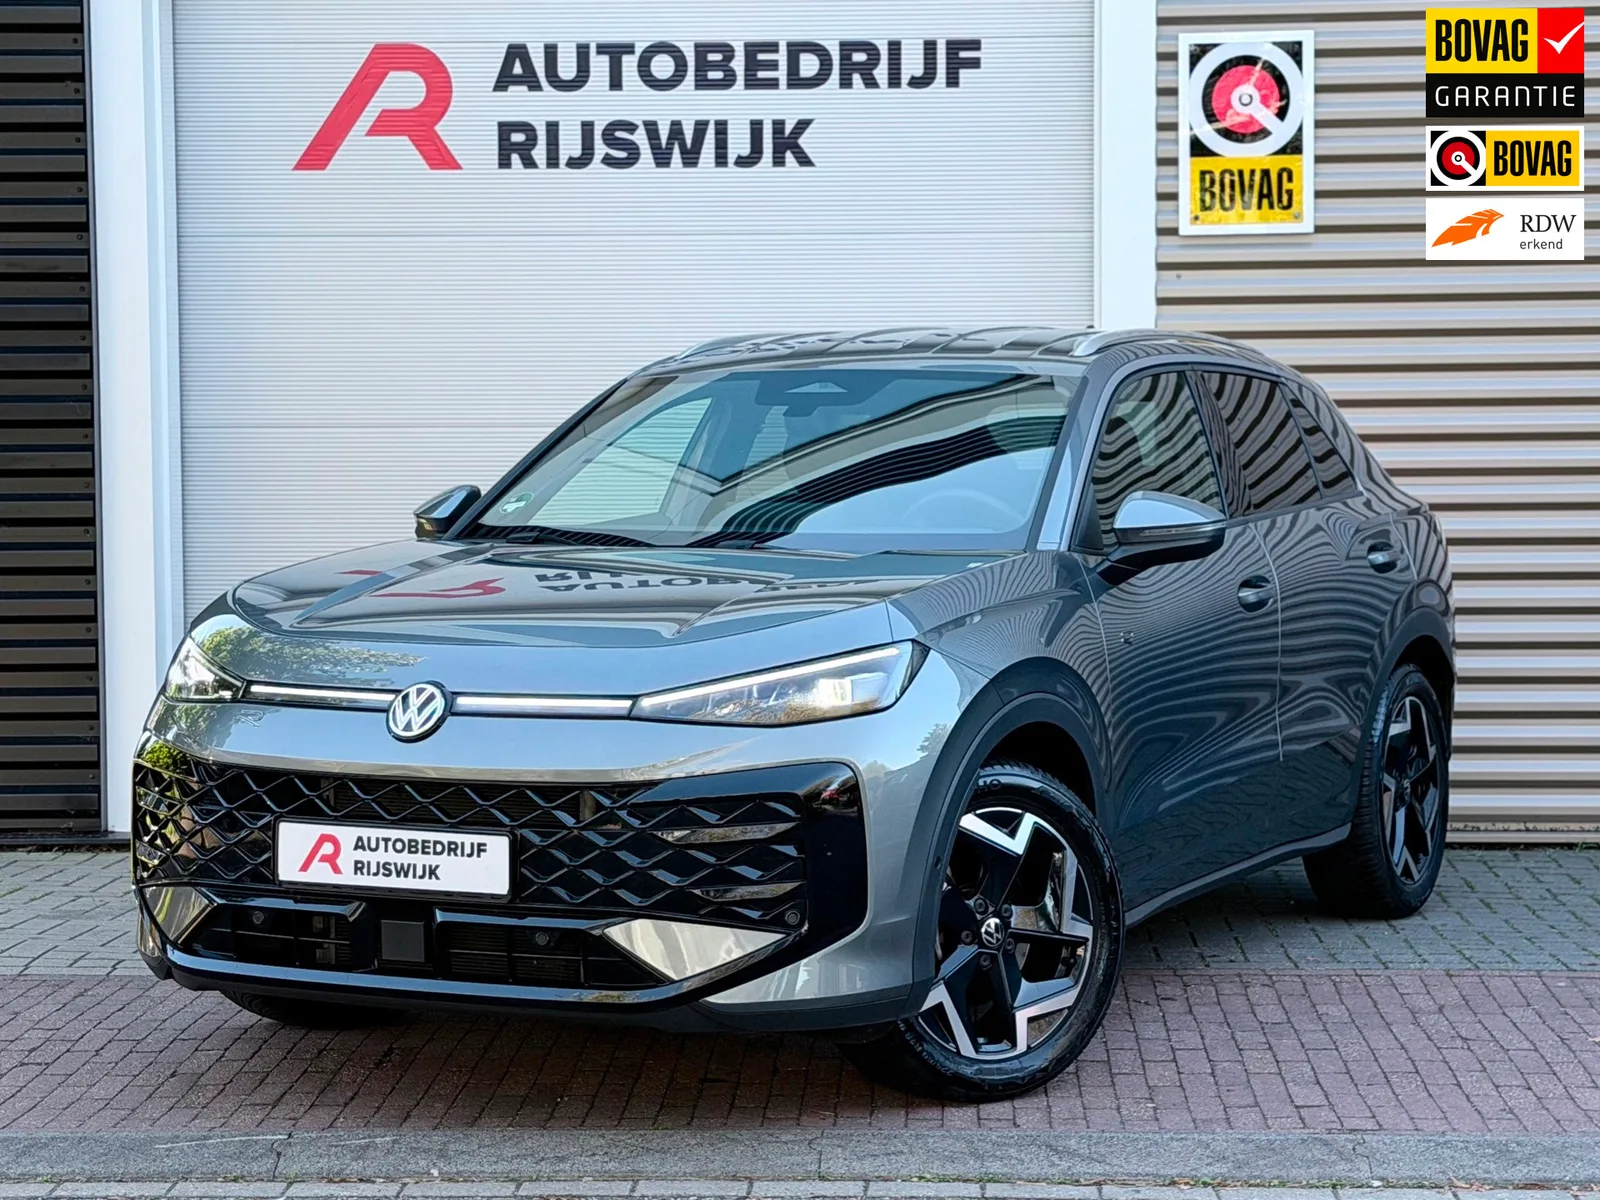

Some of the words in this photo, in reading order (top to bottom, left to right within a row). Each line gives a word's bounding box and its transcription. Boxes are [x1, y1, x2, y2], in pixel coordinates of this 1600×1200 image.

[492, 39, 982, 92] AUTOBEDRIJF
[498, 118, 815, 170] RIJSWIJK
[1200, 167, 1294, 212] BOVAG
[353, 834, 488, 859] AUTOBEDRIJF
[353, 859, 441, 881] RIJSWIJK
